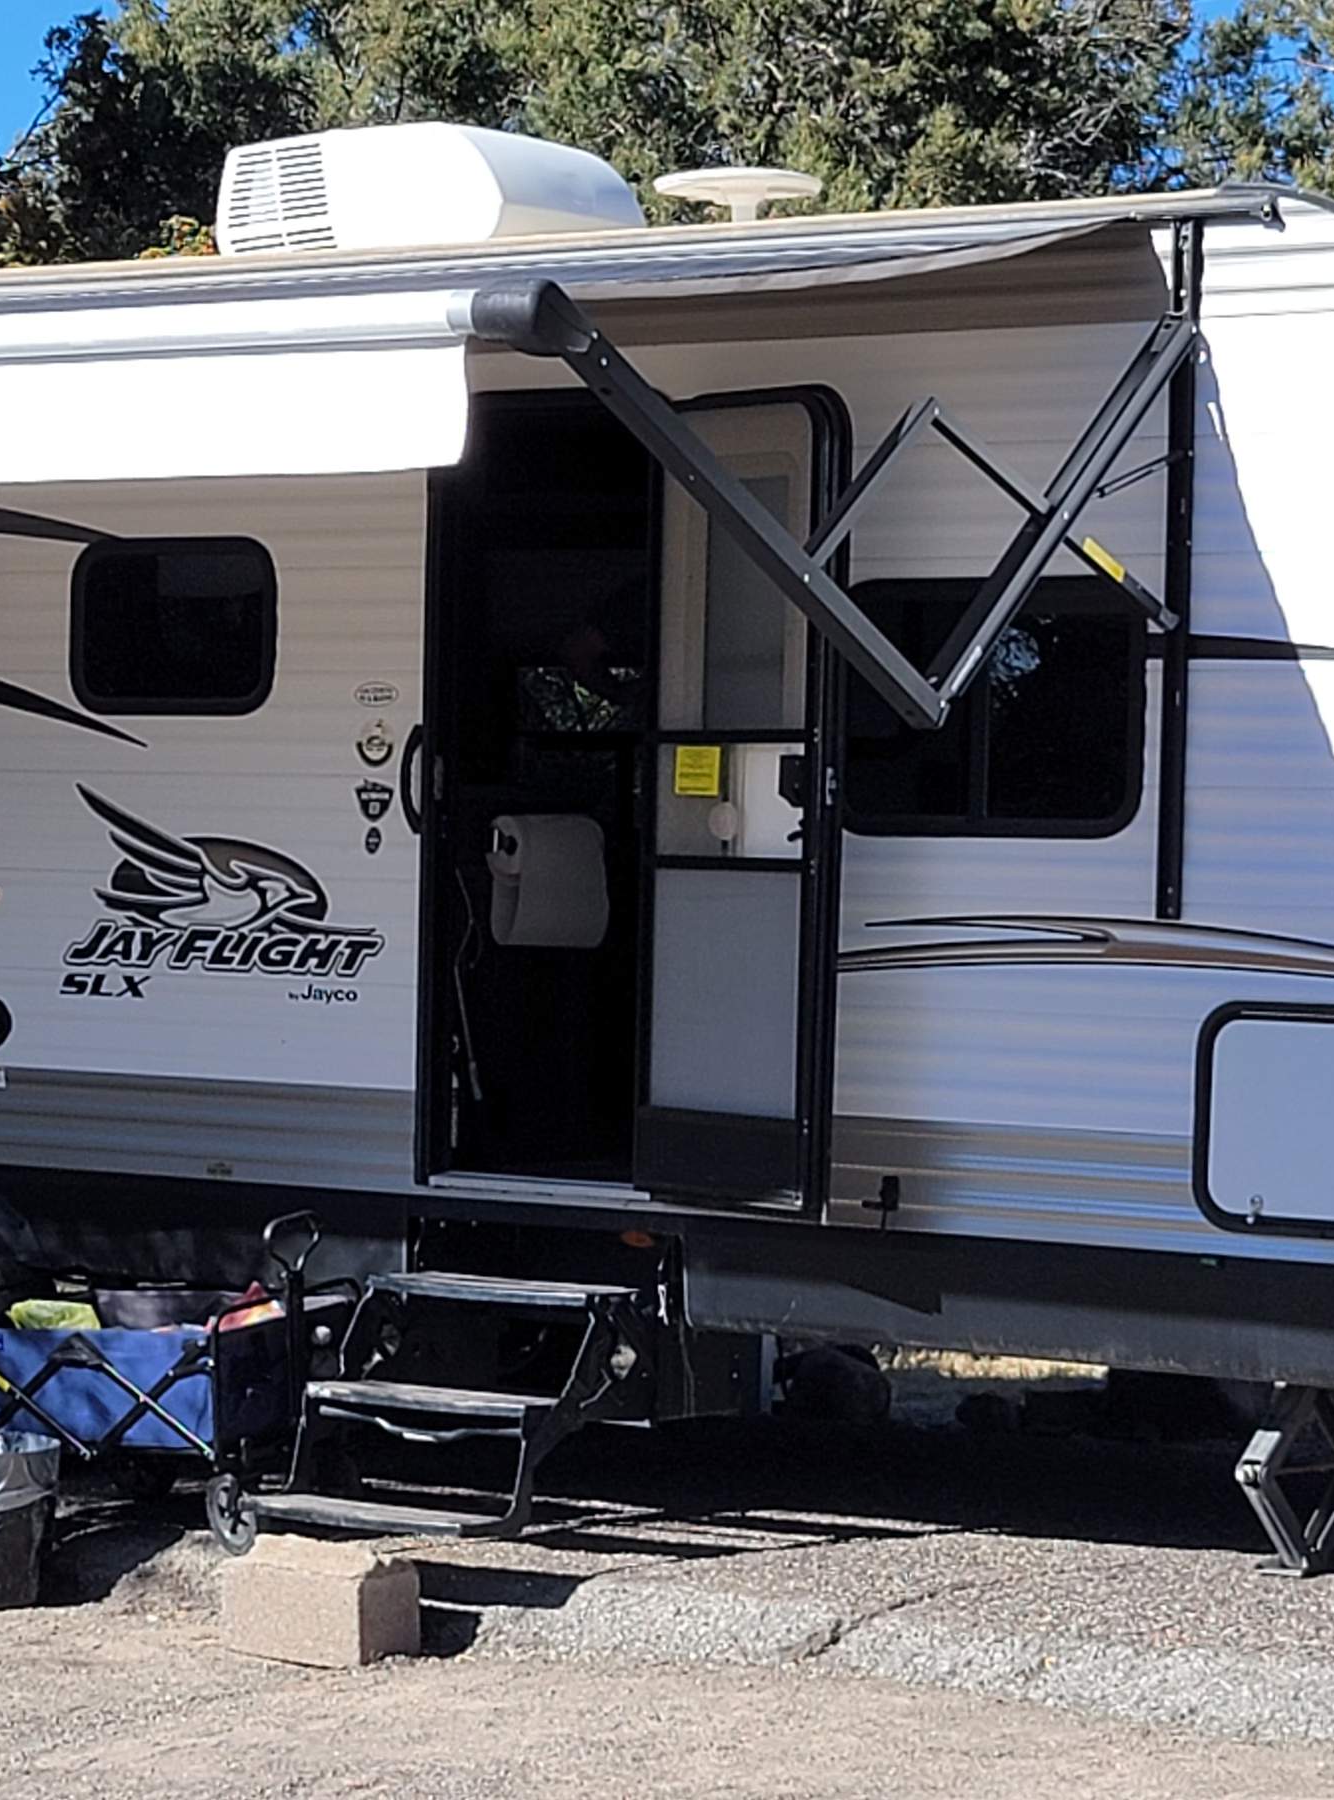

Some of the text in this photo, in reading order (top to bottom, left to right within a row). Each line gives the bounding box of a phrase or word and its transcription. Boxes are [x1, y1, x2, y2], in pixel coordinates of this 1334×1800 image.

[64, 921, 384, 976] JAY FLIGHT
[60, 973, 152, 998] SLX
[301, 984, 358, 1005] Jayco
